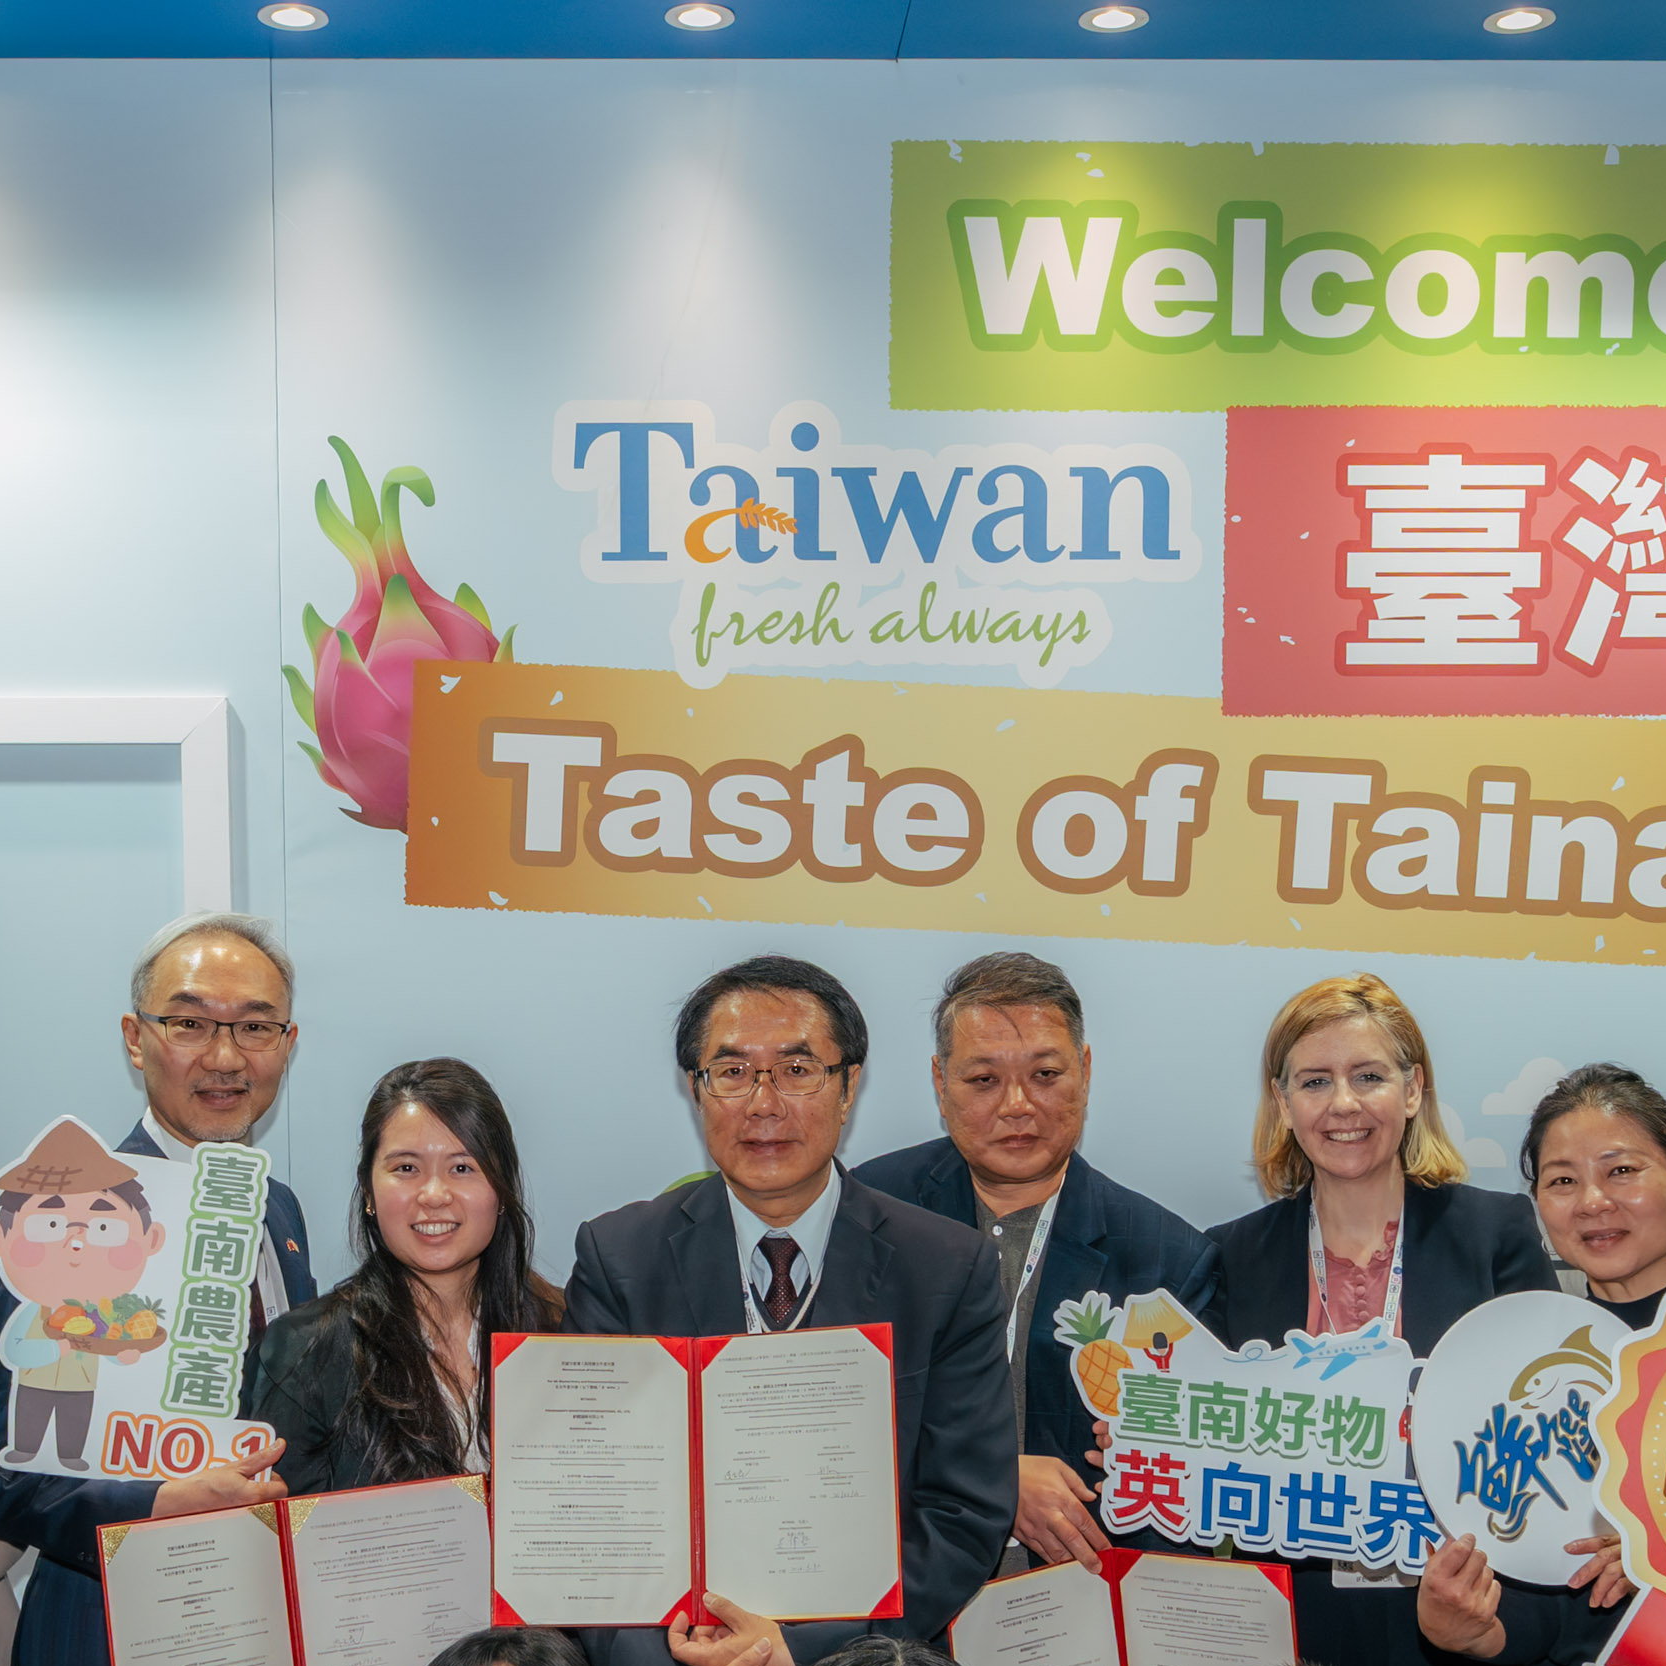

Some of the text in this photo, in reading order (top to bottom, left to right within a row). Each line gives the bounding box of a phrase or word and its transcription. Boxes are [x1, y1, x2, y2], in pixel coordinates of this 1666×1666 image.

[573, 420, 1182, 565] Taiwan
[691, 581, 1092, 669] fresh always
[492, 731, 973, 871] Taste
[1030, 762, 1205, 882] of
[169, 1154, 261, 1410] 臺南農產
[110, 1420, 262, 1478] NO1
[1119, 1373, 1387, 1462] 臺南好物
[1112, 1449, 1443, 1560] 英向世界
